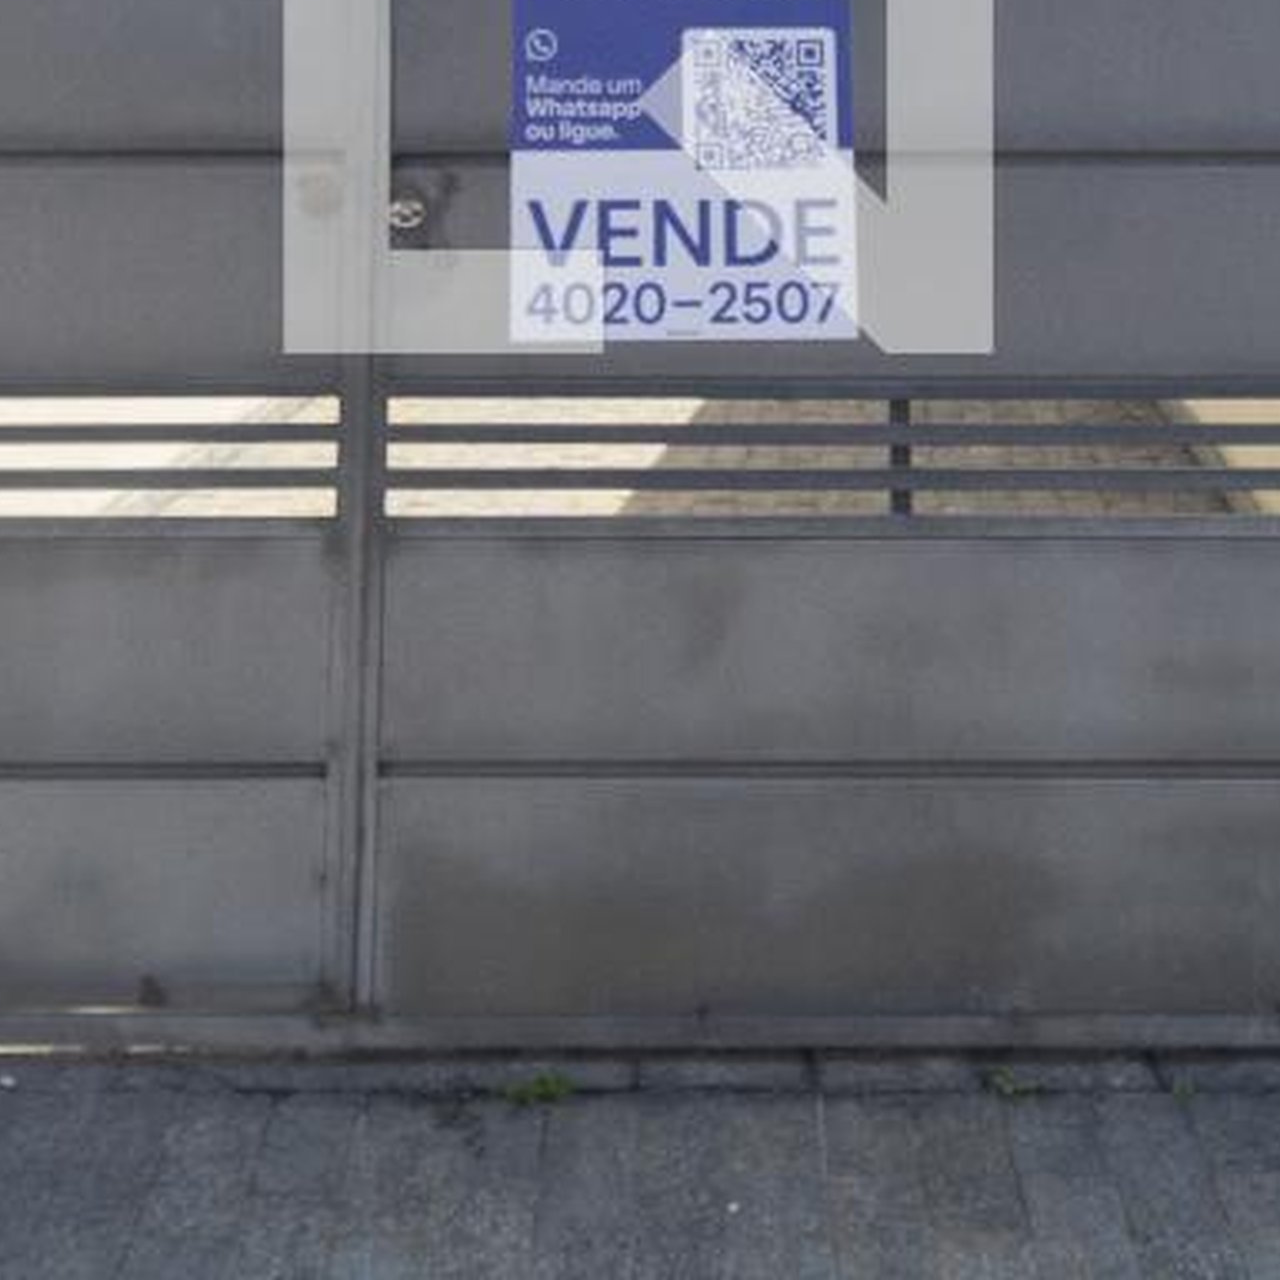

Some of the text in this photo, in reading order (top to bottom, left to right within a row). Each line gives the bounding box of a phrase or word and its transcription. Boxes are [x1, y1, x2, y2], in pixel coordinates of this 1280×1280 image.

[606, 78, 642, 95] um
[525, 98, 642, 121] Whatsapp
[525, 124, 556, 140] ou
[527, 199, 840, 267] VENDE
[526, 281, 841, 325] 4020-2507
